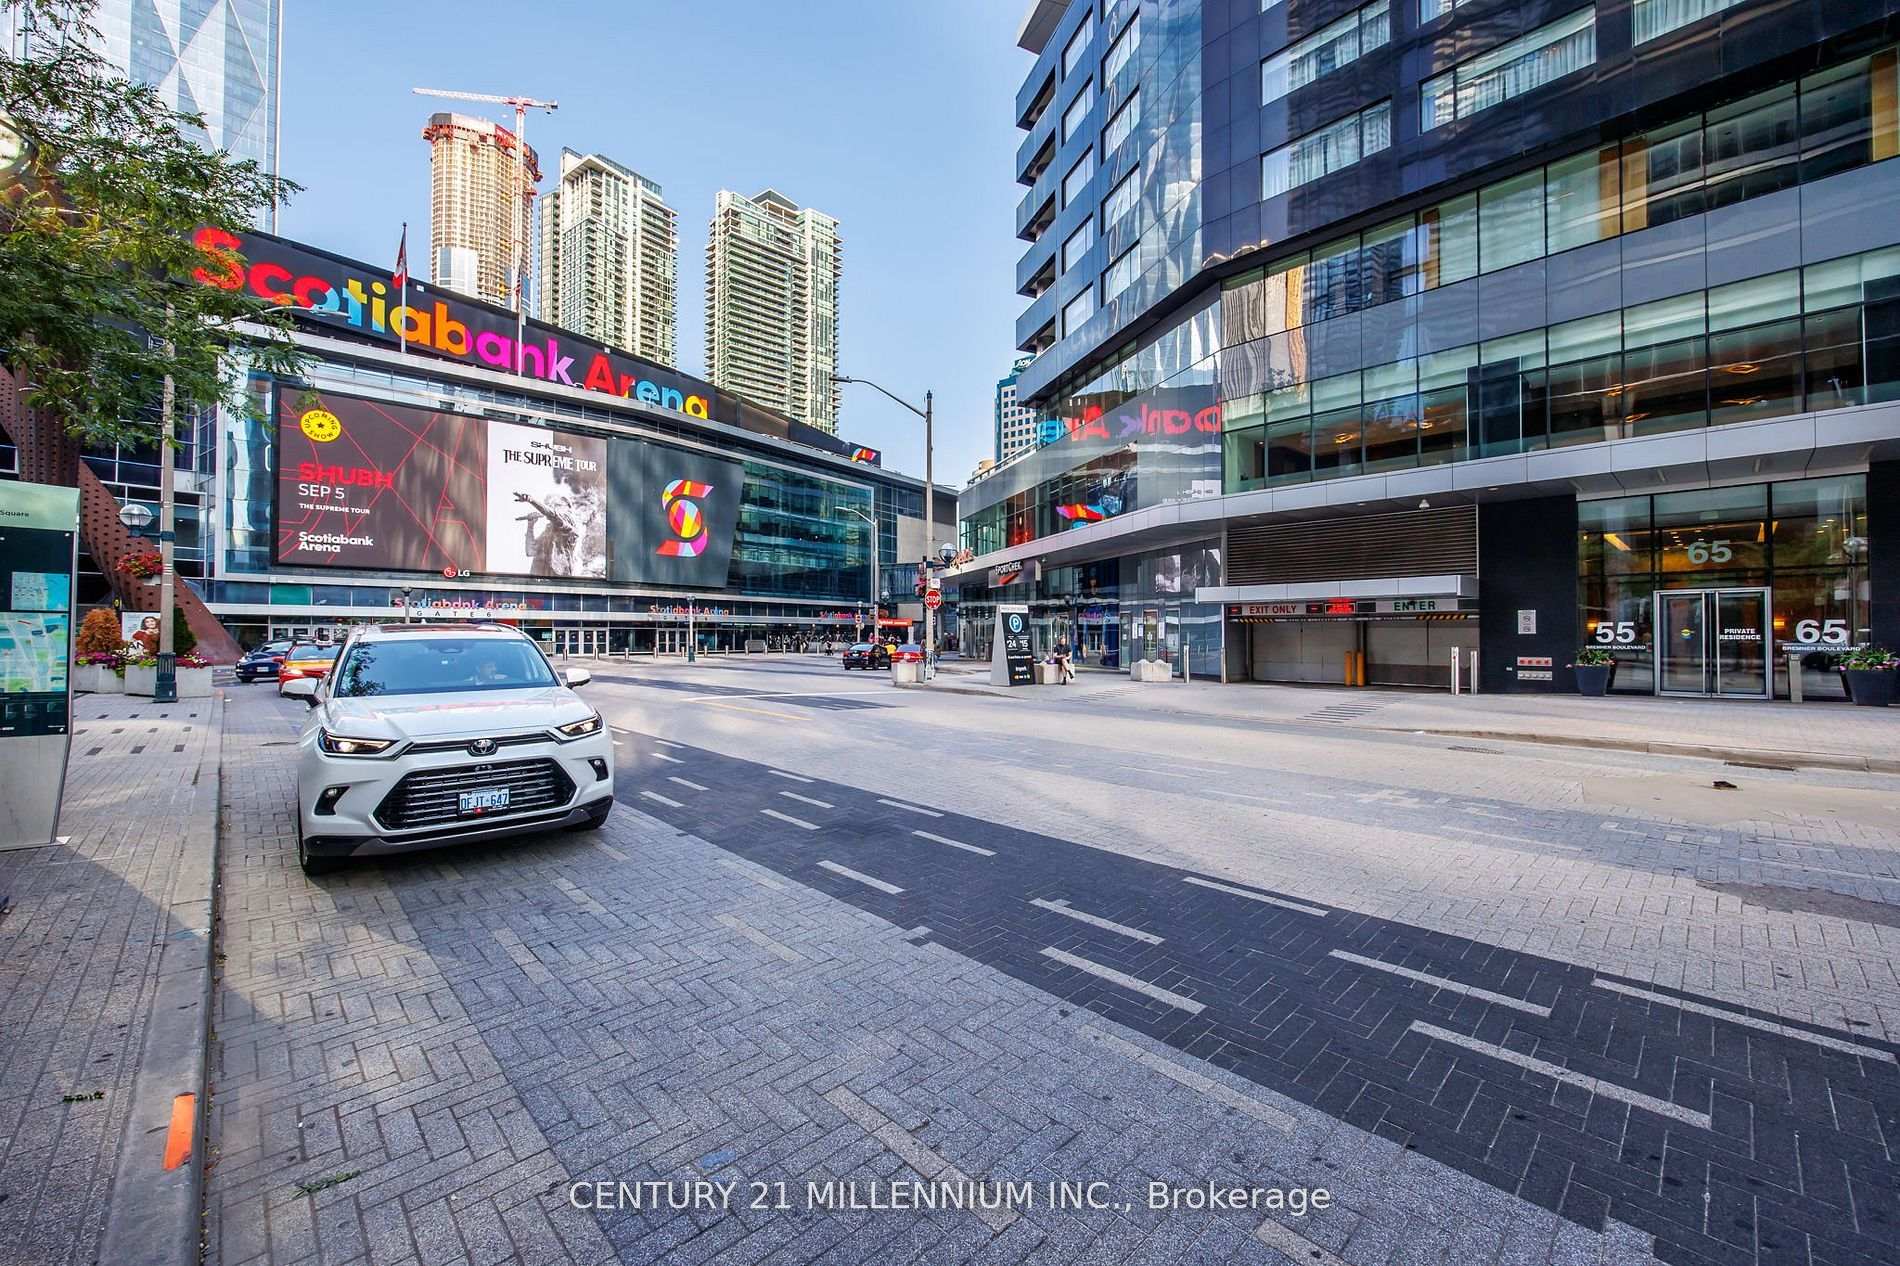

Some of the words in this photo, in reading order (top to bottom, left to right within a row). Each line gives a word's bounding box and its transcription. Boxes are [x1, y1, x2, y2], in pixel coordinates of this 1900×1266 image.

[192, 227, 575, 385] Scotiabank
[584, 352, 709, 420] Arena
[304, 412, 338, 431] UPCOMING
[309, 429, 334, 440] SHOW
[503, 449, 522, 463] THE
[523, 451, 574, 471] SUPREME
[575, 459, 597, 472] TOUR
[299, 463, 394, 489] SHUBH
[298, 484, 331, 498] SEP
[335, 487, 345, 499] 5
[315, 504, 350, 513] SUPREME
[299, 531, 374, 546] Scotiabank
[298, 542, 341, 552] Arena
[1687, 539, 1733, 565] 65
[457, 569, 470, 577] LG
[393, 598, 480, 610] Scotiabank
[484, 599, 528, 610] Arena
[926, 595, 941, 603] STOP
[1394, 600, 1436, 612] ENTER
[1249, 605, 1273, 614] EXIT
[1273, 604, 1297, 614] ONLY
[1595, 621, 1636, 643] 55
[1795, 619, 1848, 644] 65
